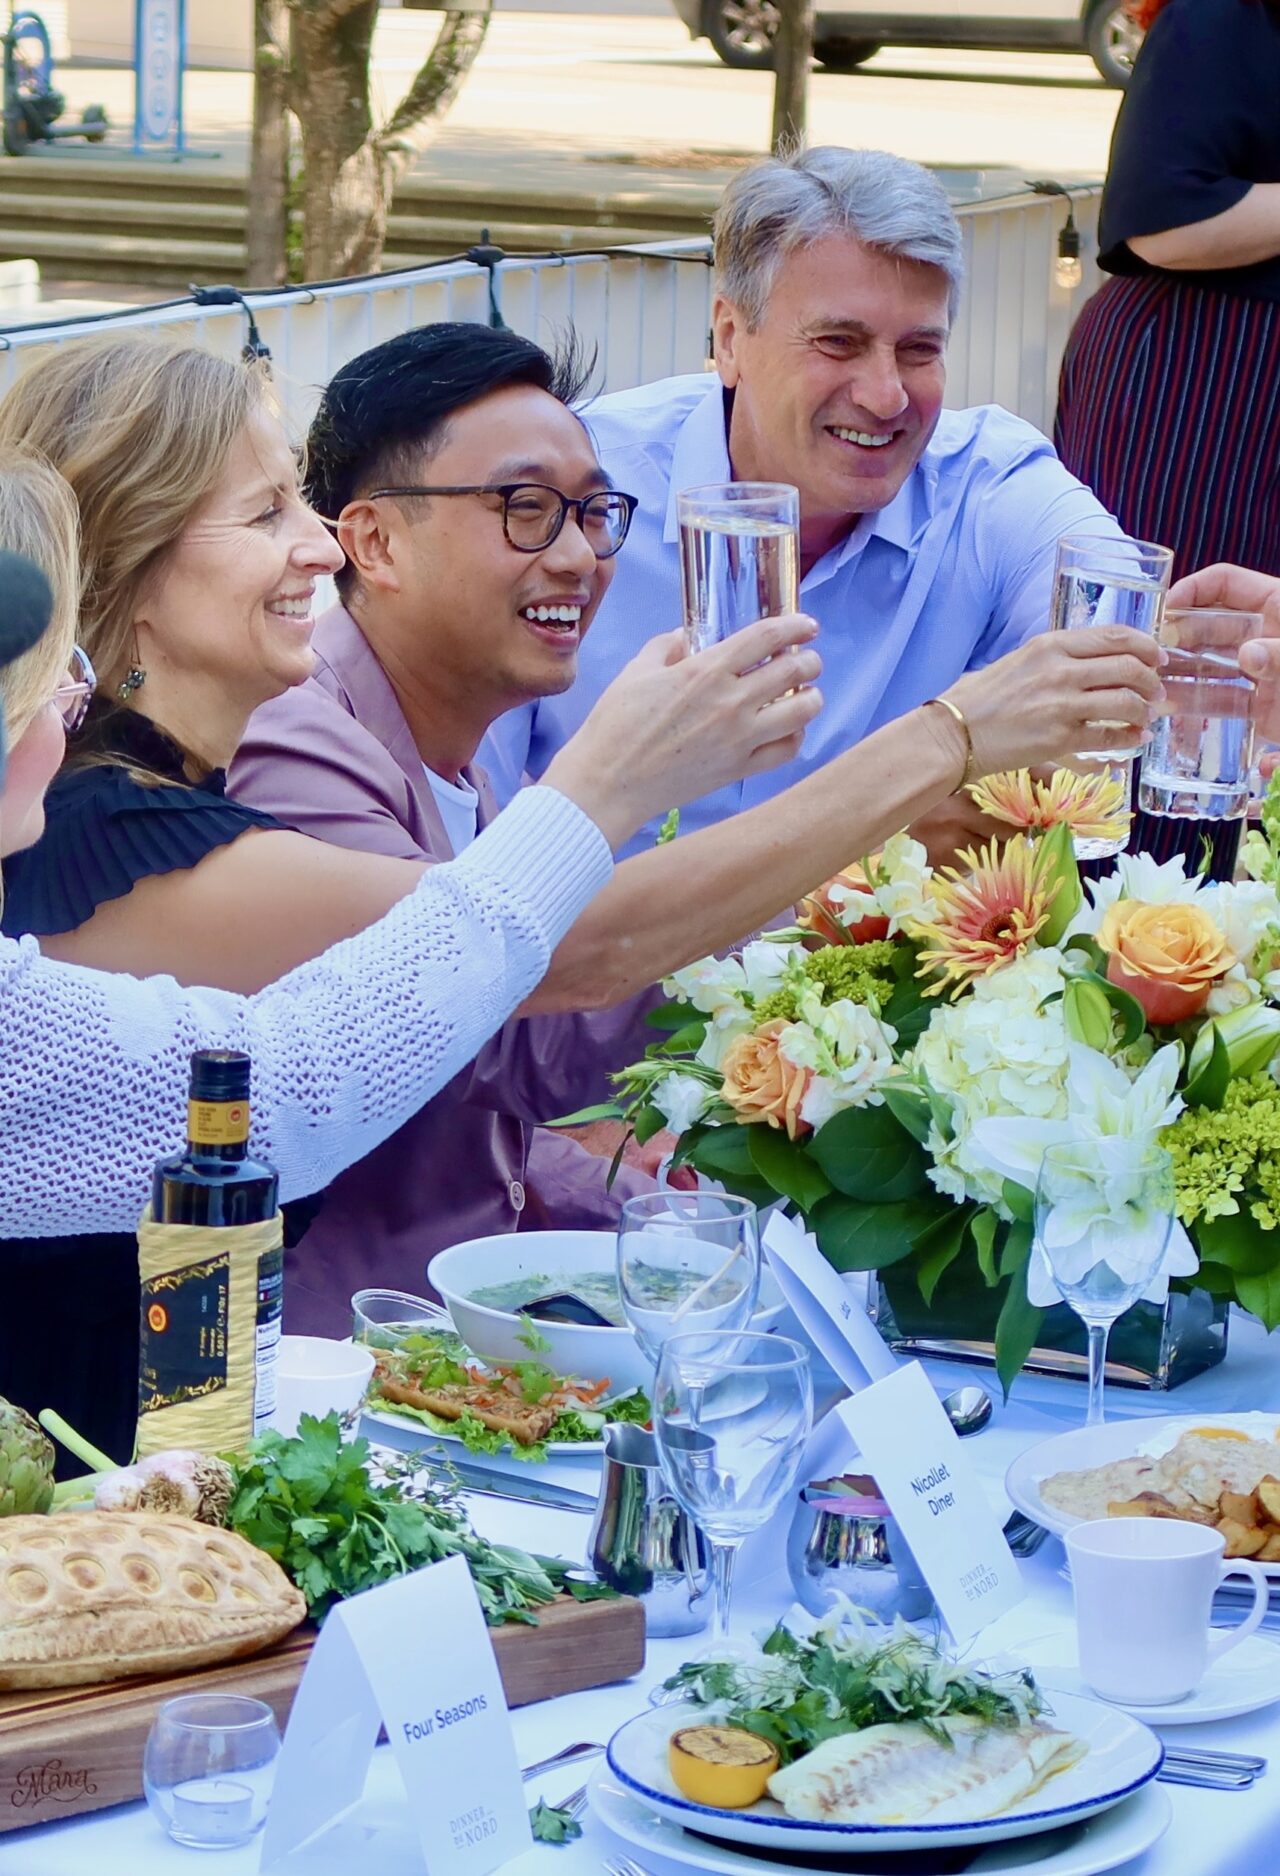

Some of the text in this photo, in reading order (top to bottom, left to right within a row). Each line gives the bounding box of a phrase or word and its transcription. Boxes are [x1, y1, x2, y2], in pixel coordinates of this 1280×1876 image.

[911, 1462, 950, 1497] Nicollet
[928, 1491, 956, 1516] Diner
[959, 1563, 985, 1588] DINNER
[973, 1572, 999, 1598] NORD
[403, 1694, 488, 1744] Four Seasons
[449, 1806, 485, 1834] DINNER
[464, 1817, 498, 1847] NORD
